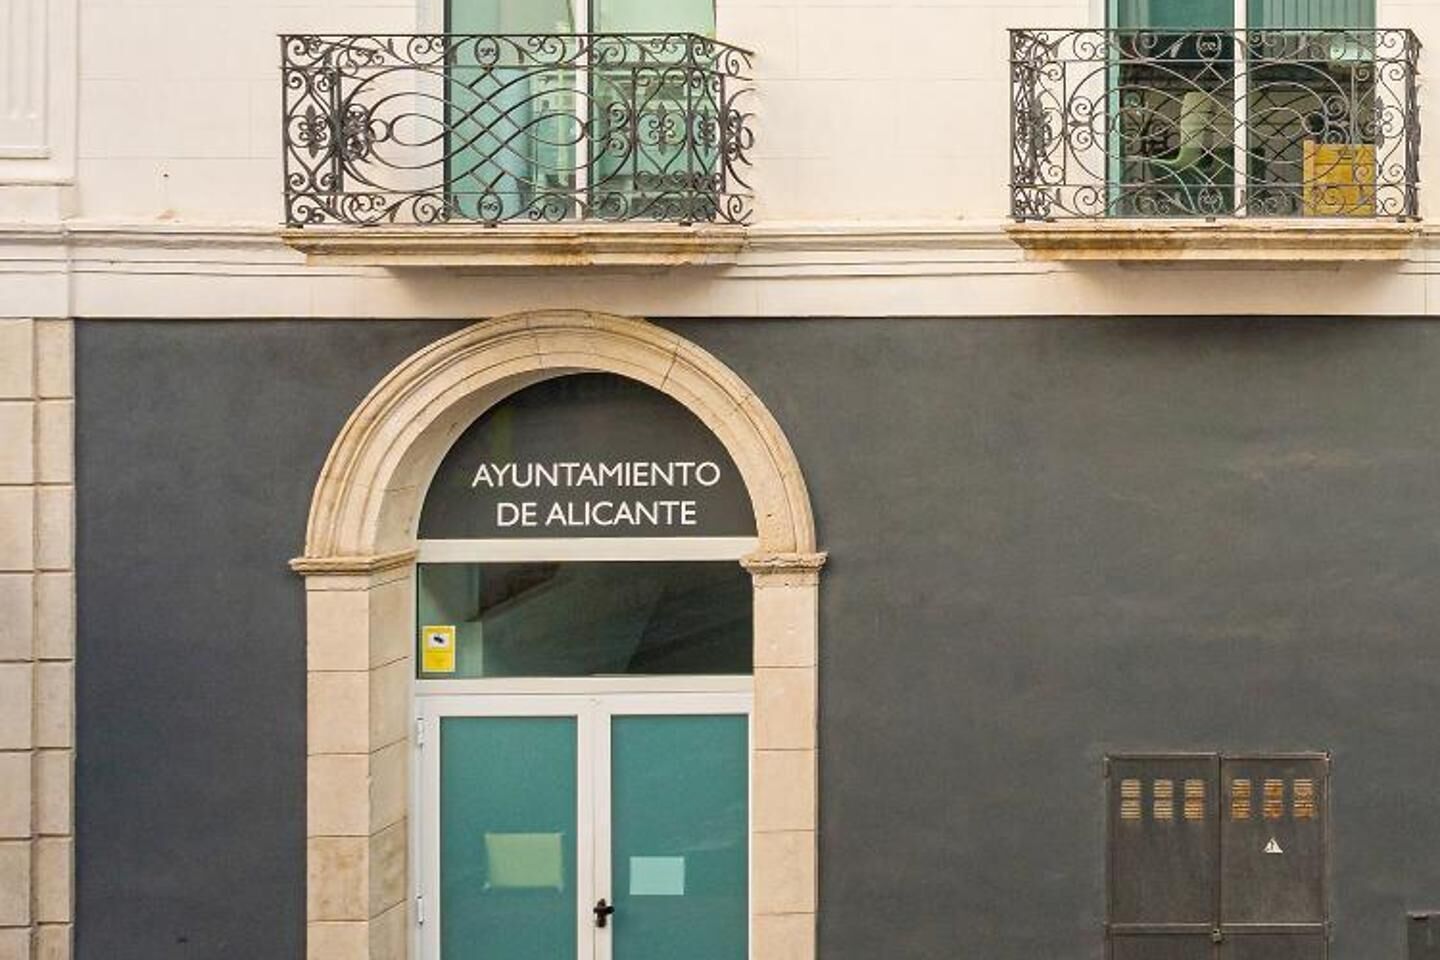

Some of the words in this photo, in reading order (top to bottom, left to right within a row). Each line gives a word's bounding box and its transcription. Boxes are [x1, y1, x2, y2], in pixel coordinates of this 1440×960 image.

[472, 461, 721, 488] AYUNTAMIENTO
[497, 502, 538, 528] DE
[545, 500, 697, 527] ALICANTE
